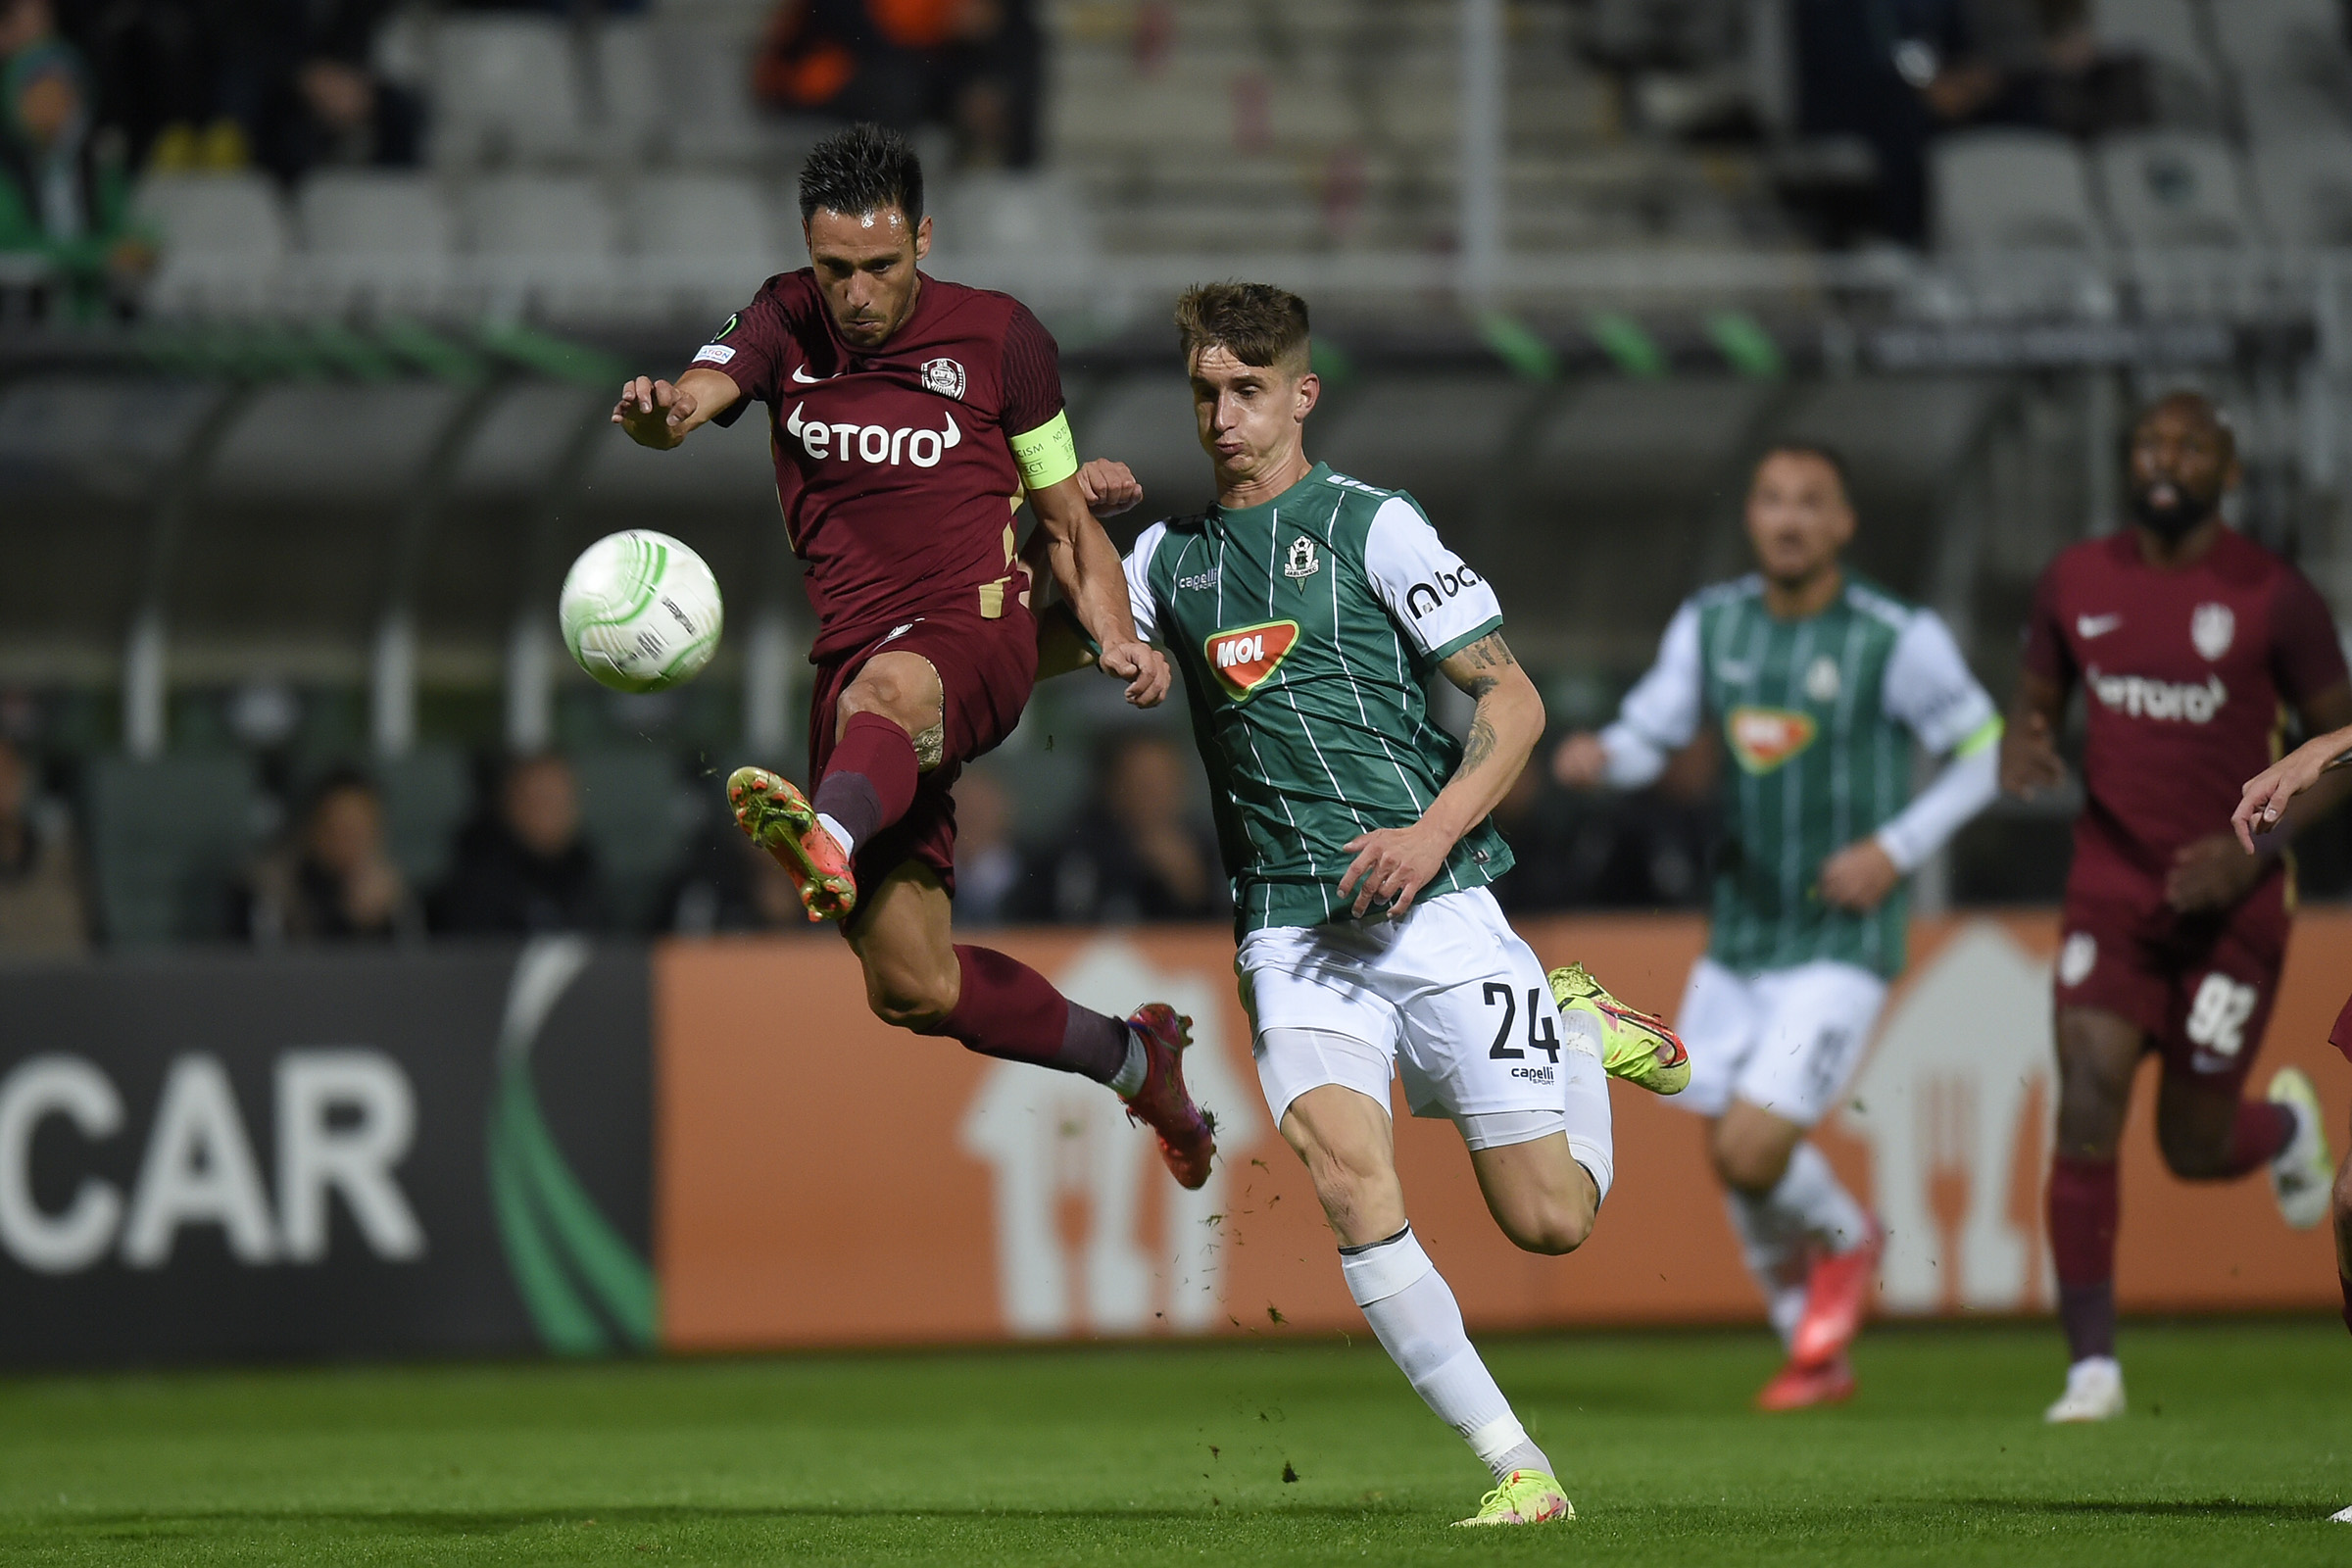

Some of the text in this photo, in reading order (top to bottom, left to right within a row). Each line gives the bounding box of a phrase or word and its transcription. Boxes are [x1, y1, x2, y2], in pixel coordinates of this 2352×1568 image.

[1179, 568, 1217, 589] capelli
[1286, 566, 1317, 576] JABLONEC
[1217, 635, 1264, 668] MOL
[1483, 982, 1560, 1063] 24
[2186, 971, 2257, 1055] 92
[1511, 1066, 1554, 1081] capelli
[0, 1049, 427, 1272] CAR
